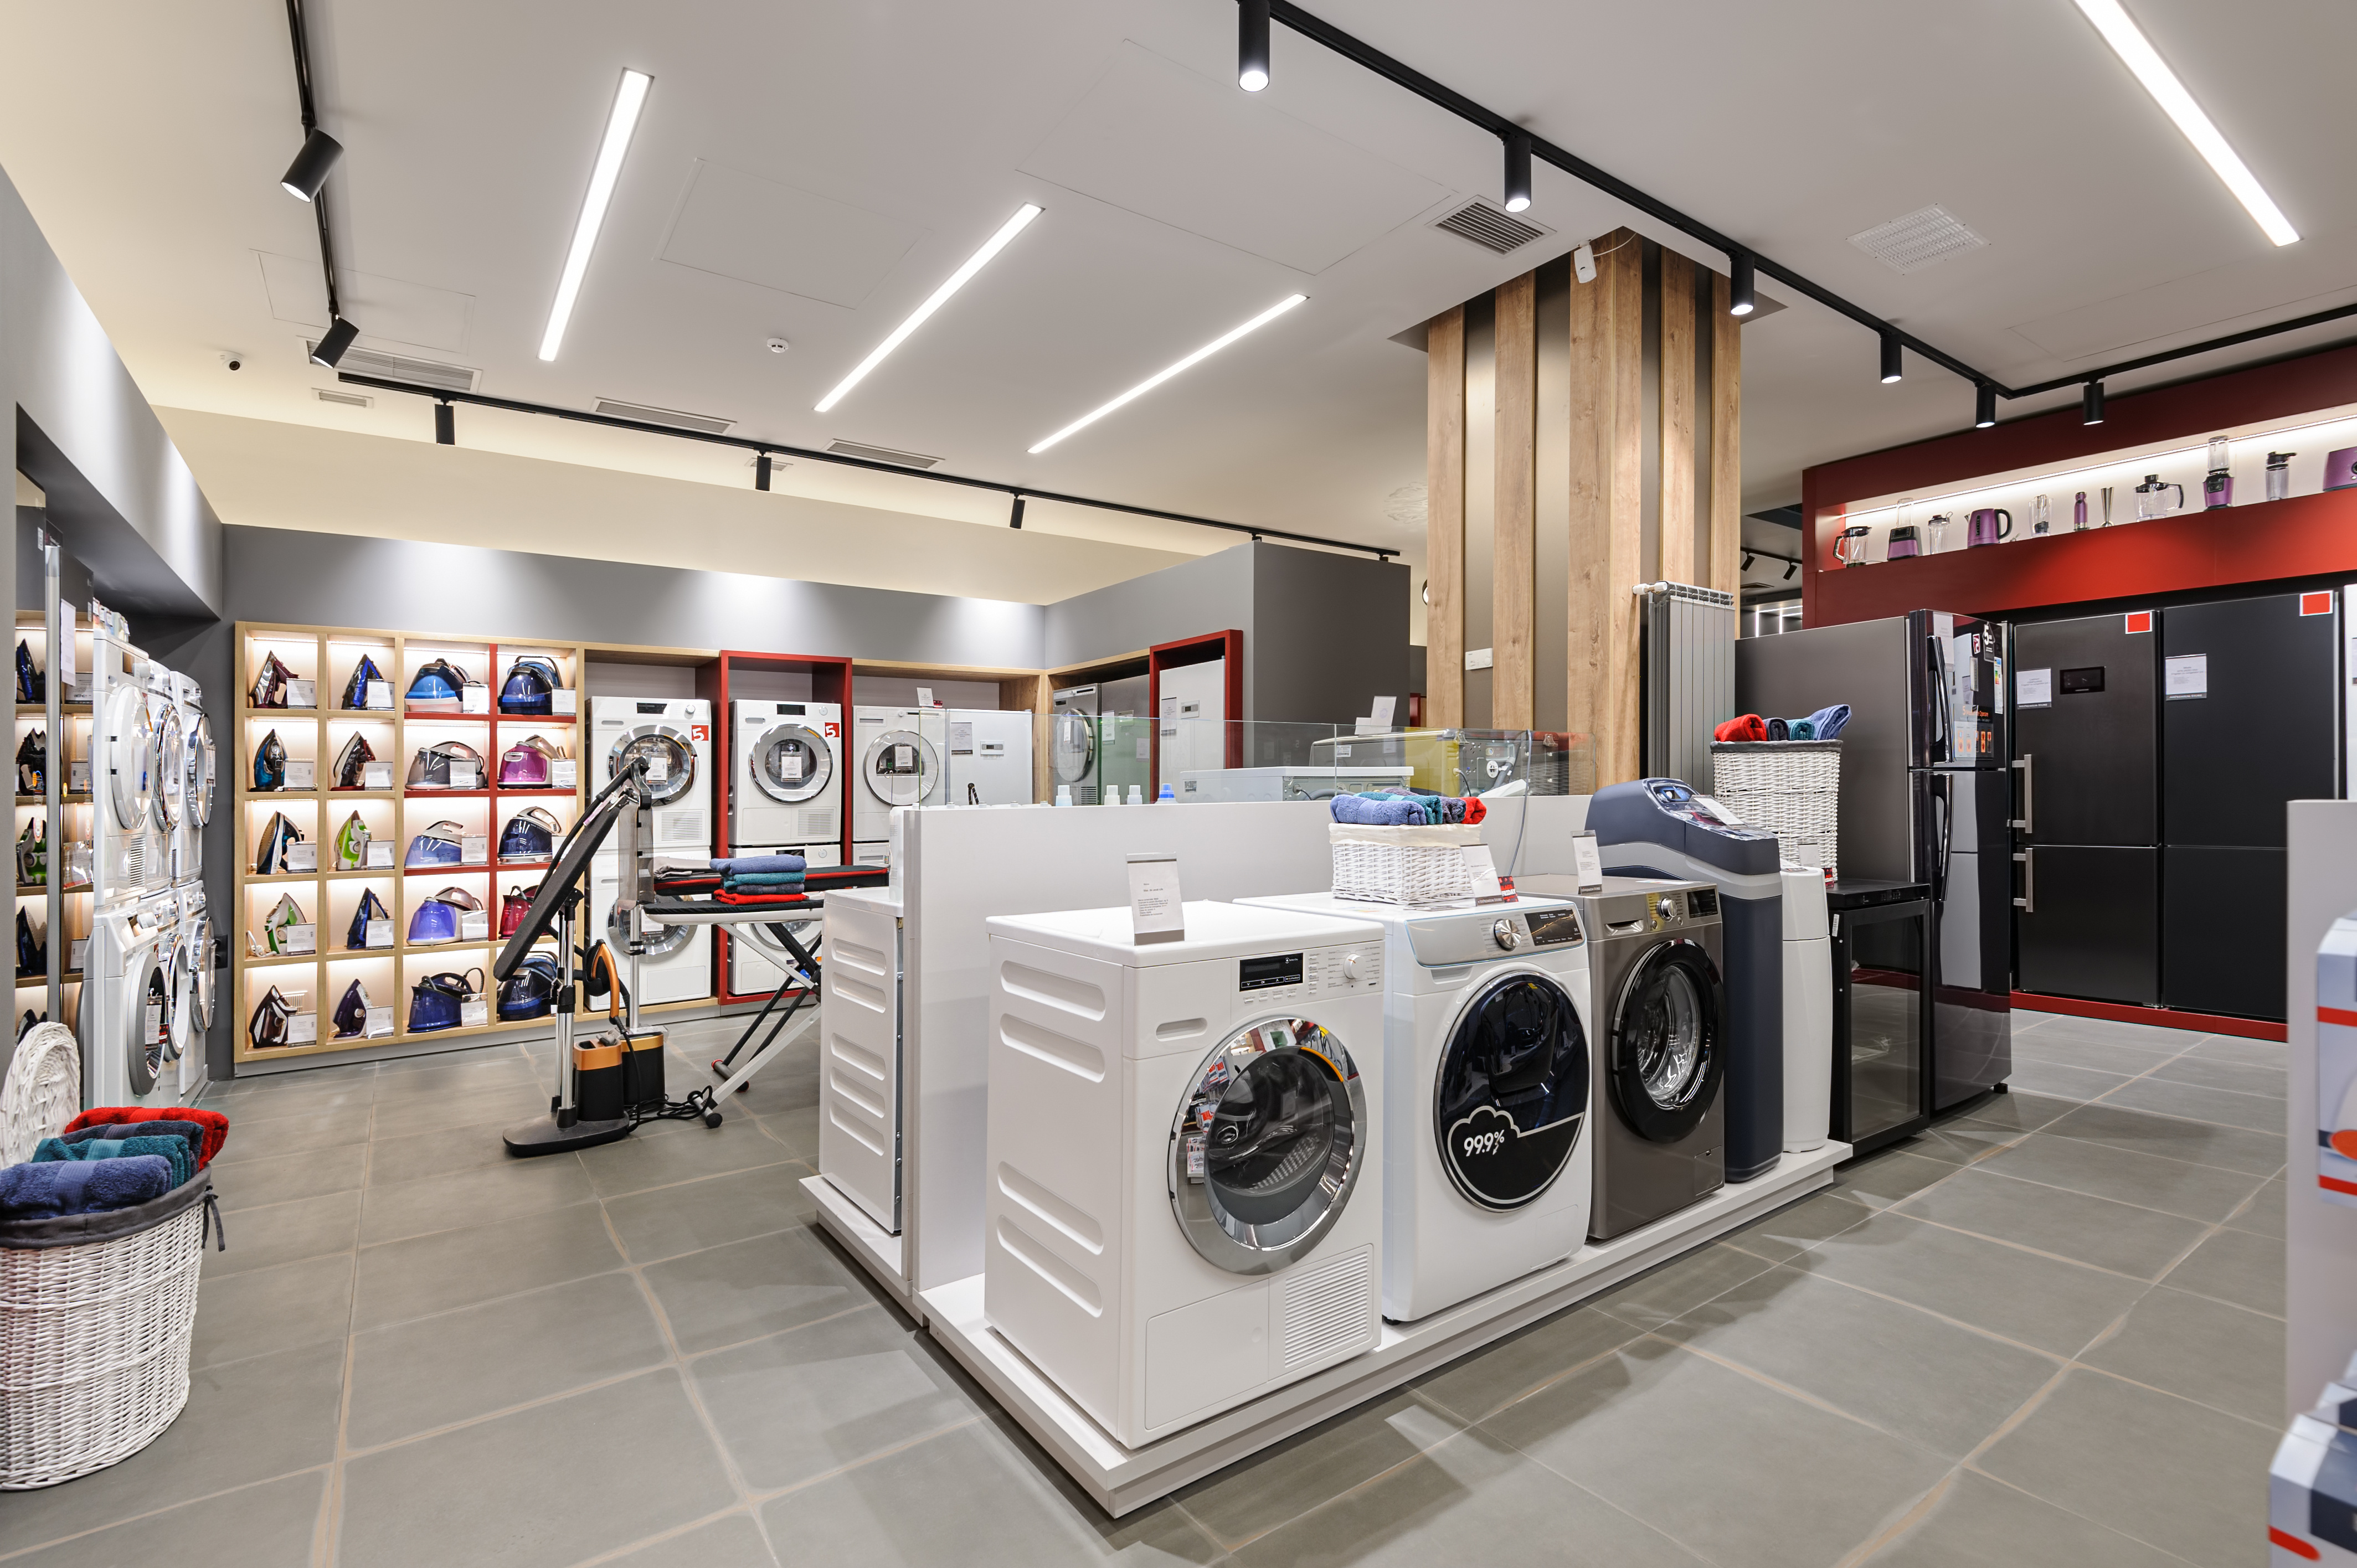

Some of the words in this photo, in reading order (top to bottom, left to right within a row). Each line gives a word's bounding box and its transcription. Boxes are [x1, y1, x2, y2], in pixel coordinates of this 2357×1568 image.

[692, 728, 704, 741] 5
[825, 725, 836, 737] 5
[1464, 1129, 1505, 1157] 99.9%
